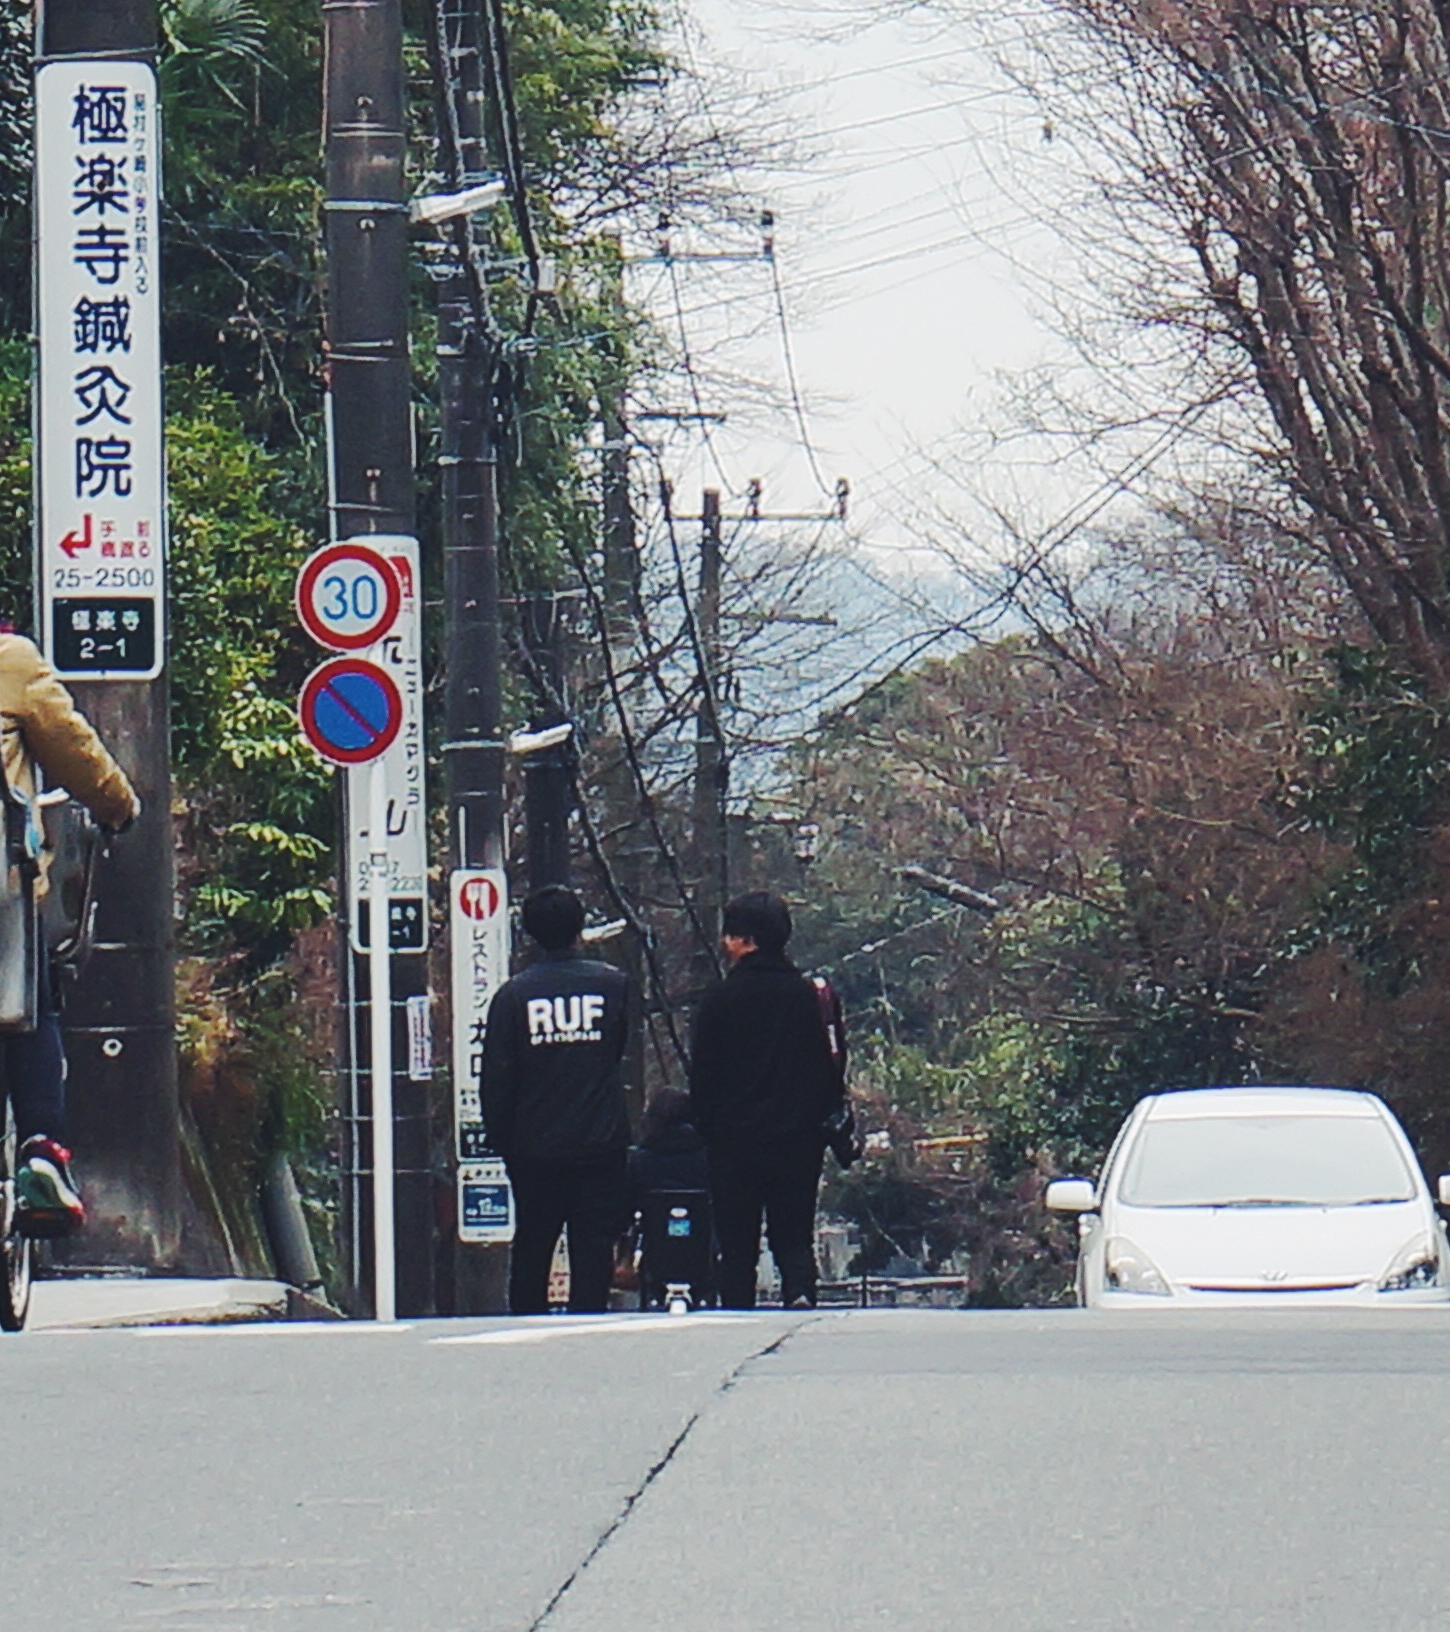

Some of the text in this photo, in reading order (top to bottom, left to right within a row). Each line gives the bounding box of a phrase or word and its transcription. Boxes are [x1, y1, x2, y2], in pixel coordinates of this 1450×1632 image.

[72, 83, 133, 499] 極楽寺鍼灸院
[54, 567, 155, 589] 25-2500
[322, 574, 378, 621] 30
[71, 609, 141, 632] 極楽寺
[79, 637, 127, 659] 2-1
[527, 994, 605, 1035] RUF
